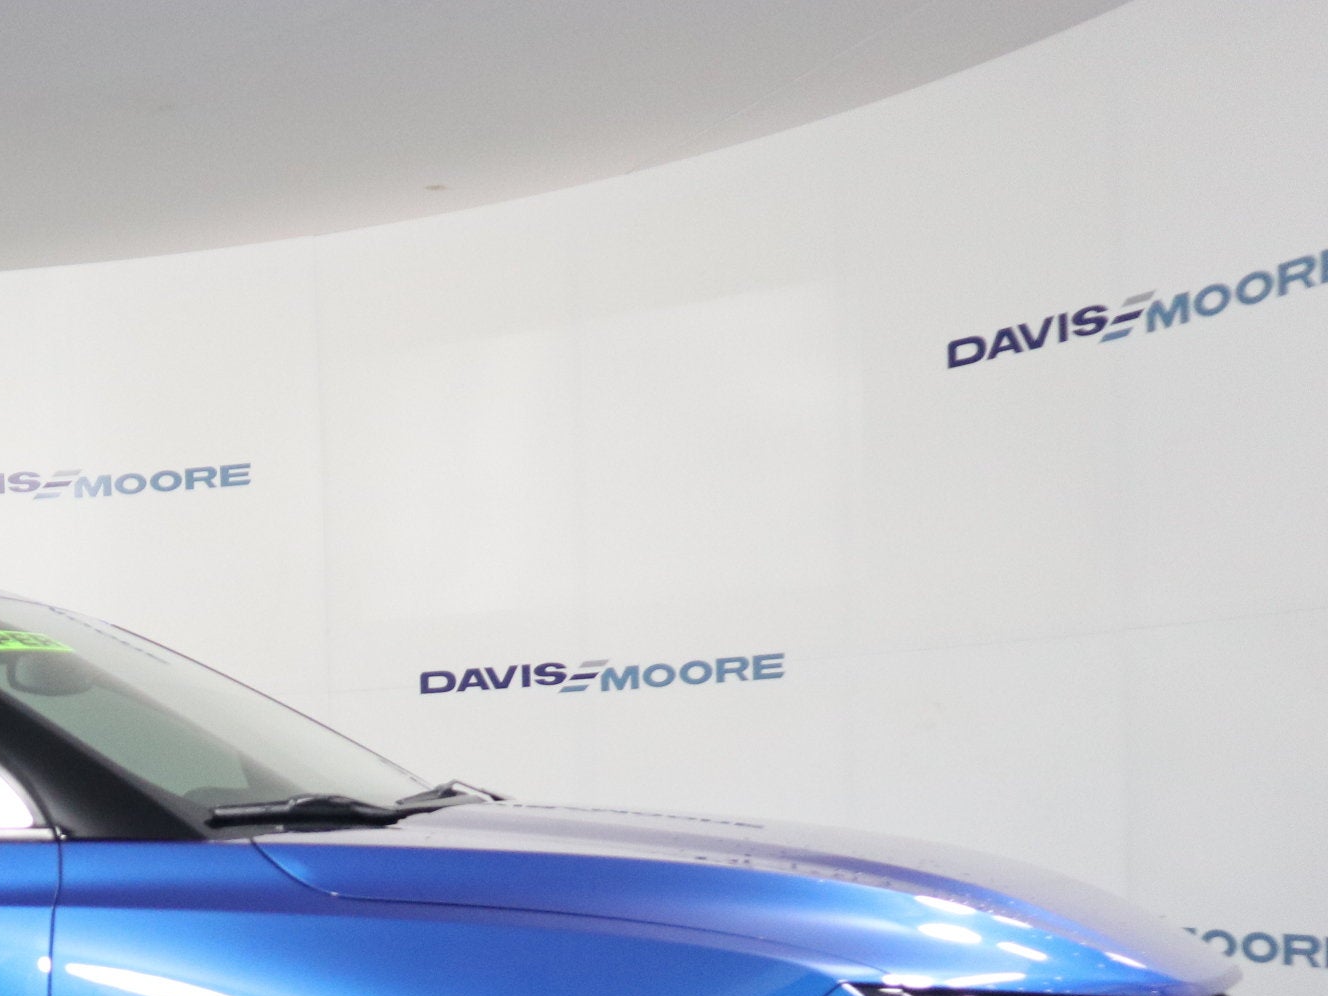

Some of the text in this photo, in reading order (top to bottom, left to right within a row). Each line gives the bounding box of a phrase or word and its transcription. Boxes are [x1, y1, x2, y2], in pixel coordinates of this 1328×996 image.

[947, 249, 1328, 369] DAVIS MOOR
[74, 462, 251, 498] MOORE
[419, 652, 785, 694] DAVIS MOORE
[1183, 927, 1328, 968] OOR
